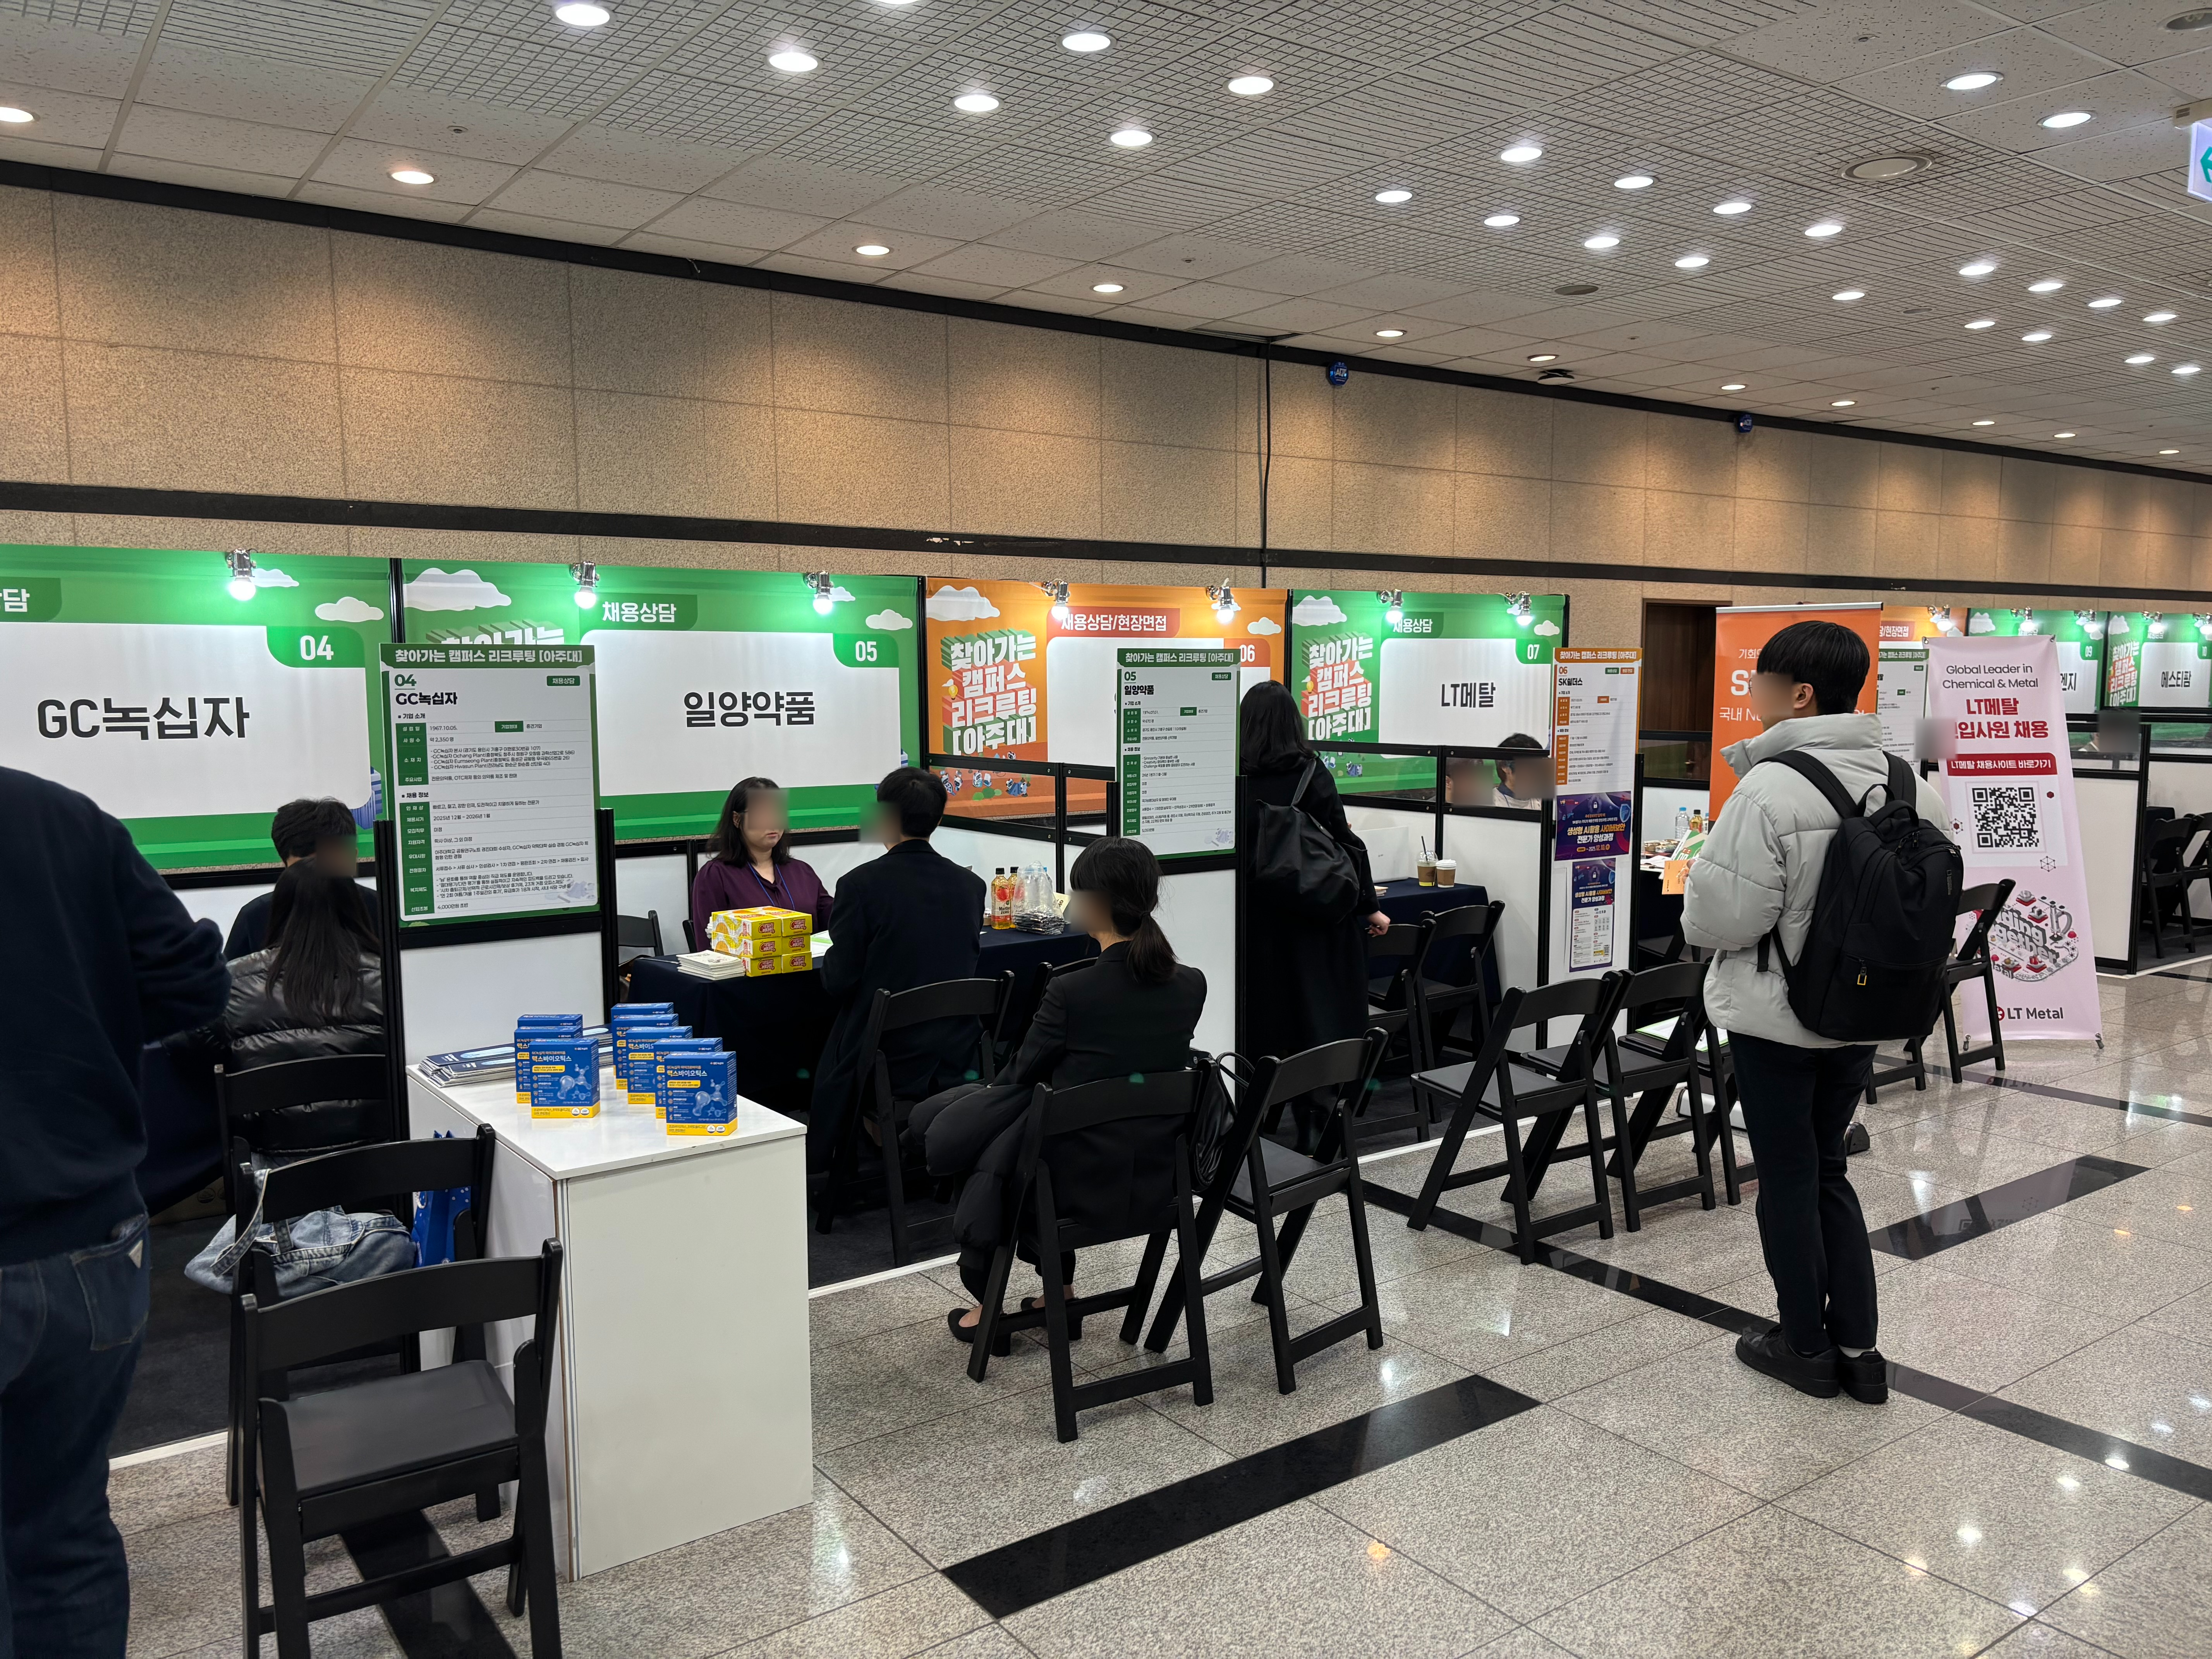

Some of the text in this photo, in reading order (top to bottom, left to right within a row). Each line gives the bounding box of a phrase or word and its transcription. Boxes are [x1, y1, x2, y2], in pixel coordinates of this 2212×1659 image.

[0, 588, 30, 613] 담
[602, 601, 677, 623] 채용상담
[1061, 613, 1167, 631] 채용상담/현장면접
[300, 635, 334, 661] 04
[395, 649, 582, 663] 찾아가는 캠퍼스 리크루팅 [아주대]
[855, 641, 877, 662] 05
[951, 634, 1036, 672] 찾아가는
[1239, 644, 1255, 662] 06
[1309, 636, 1373, 670] 찾아가는
[1527, 644, 1540, 660] 07
[1560, 651, 1580, 659] 찾아가는
[1125, 653, 1233, 663] 찾아가는 캠퍼스 리크루팅 [아주대]
[1124, 671, 1137, 681] 05
[1317, 661, 1364, 692] 캠퍼스
[1946, 663, 2033, 674] Global Leader in
[394, 674, 417, 686] 04
[962, 663, 1026, 699] 캠퍼스
[1558, 678, 1583, 686] SK쉴더스
[1942, 678, 2039, 689] Chemical & Metal
[2161, 671, 2191, 688] 에스티팜
[395, 692, 458, 705] GC녹십자
[1124, 685, 1154, 696] 일양약품
[1441, 682, 1496, 708] LT메탈
[951, 688, 1037, 728] 리크루팅
[1308, 682, 1372, 718] 리크루팅
[1966, 698, 2019, 715] LT메탈
[37, 696, 250, 740] GC녹십자
[684, 691, 815, 728] 일양약품
[1719, 707, 1743, 721] 국내
[1308, 707, 1371, 741] [아주대]
[2014, 721, 2049, 738] 채용
[953, 716, 1037, 756] [아주대]
[1976, 760, 2017, 769] 채용사이트
[2018, 759, 2051, 768] 바로가기
[1993, 923, 2056, 964] gether
[2007, 1007, 2064, 1020] LT Metal
